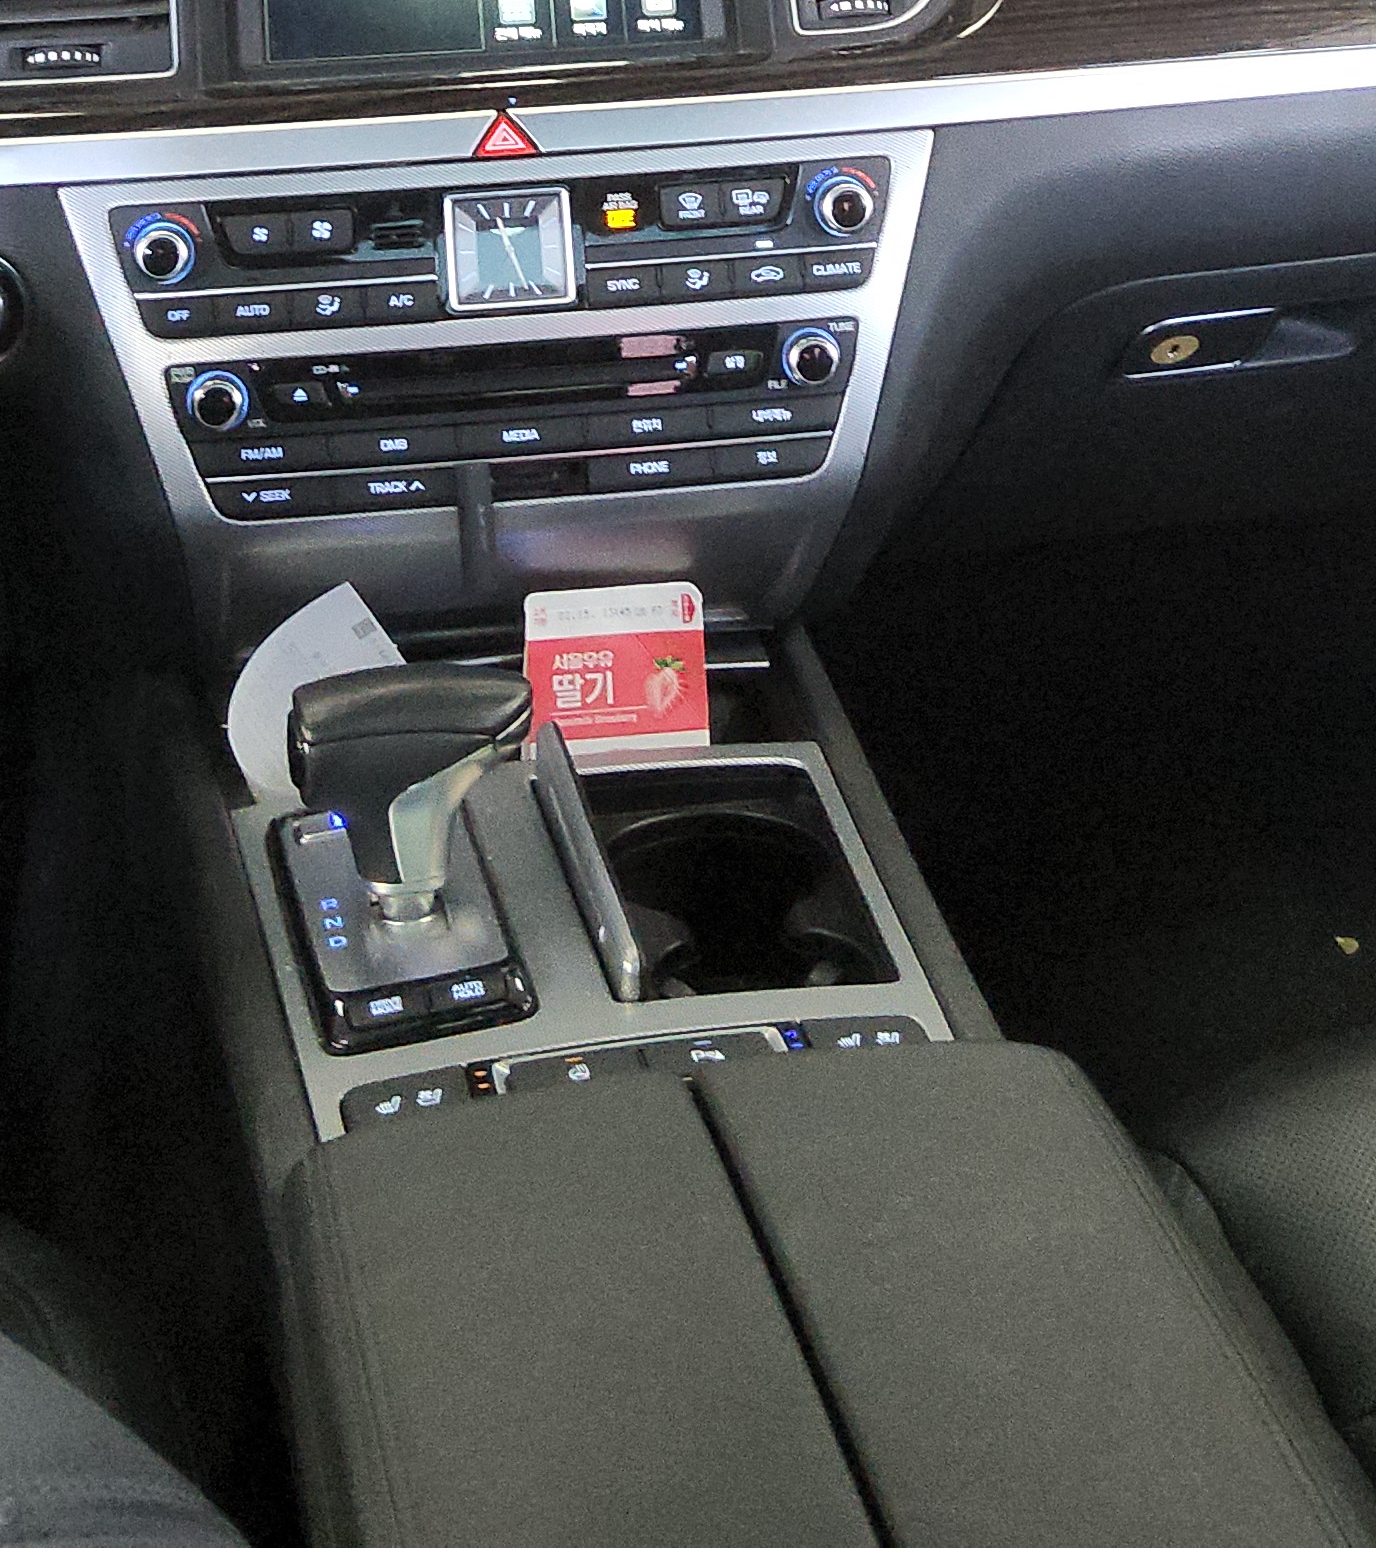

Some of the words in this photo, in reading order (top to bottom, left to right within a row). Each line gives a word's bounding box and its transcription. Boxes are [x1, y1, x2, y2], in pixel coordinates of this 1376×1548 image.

[812, 261, 861, 276] CLIMATE
[606, 278, 640, 292] SYNC
[388, 294, 415, 308] A/C
[166, 309, 191, 322] OFF
[235, 304, 271, 317] AUTO
[501, 428, 541, 443] MEDIA
[379, 437, 409, 452] DMB
[240, 447, 284, 461] FM/AM
[629, 460, 671, 475] PHONE
[259, 489, 292, 502] SEEK
[368, 481, 407, 496] TRACK
[552, 650, 614, 670] 서울우유
[552, 670, 614, 709] 딸기
